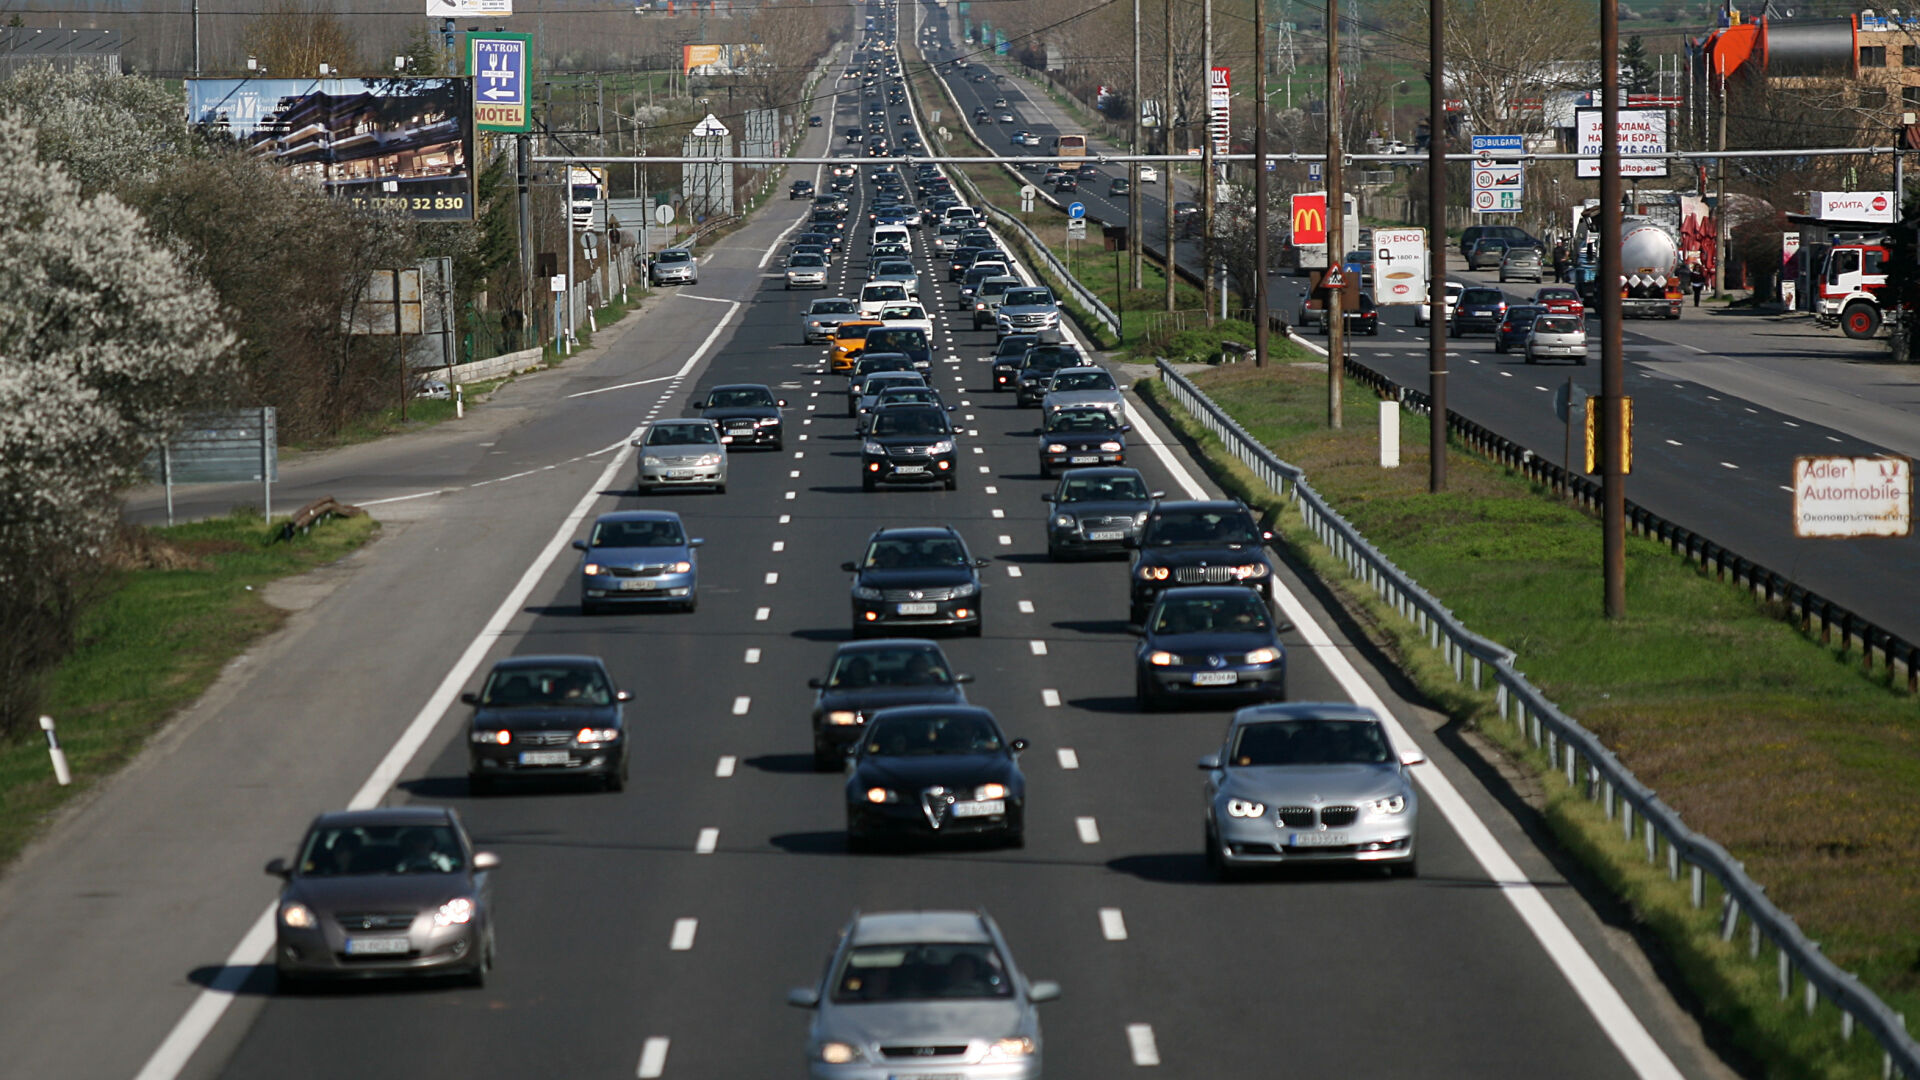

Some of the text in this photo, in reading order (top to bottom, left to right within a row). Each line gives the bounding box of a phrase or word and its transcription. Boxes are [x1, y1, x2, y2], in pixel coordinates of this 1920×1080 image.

[479, 43, 519, 52] PATRON
[475, 108, 521, 121] MOTEL
[1487, 138, 1521, 146] BULGARIA
[1588, 134, 1601, 142] НА
[1631, 134, 1658, 143] БОРД
[1480, 175, 1490, 184] 90
[412, 197, 432, 210] 32
[434, 197, 463, 210] 830
[1480, 196, 1491, 204] 140
[1828, 201, 1864, 209] ЮЛИТА
[1393, 234, 1421, 243] ENCO
[1803, 464, 1848, 478] Adler
[1803, 484, 1901, 500] Automobile
